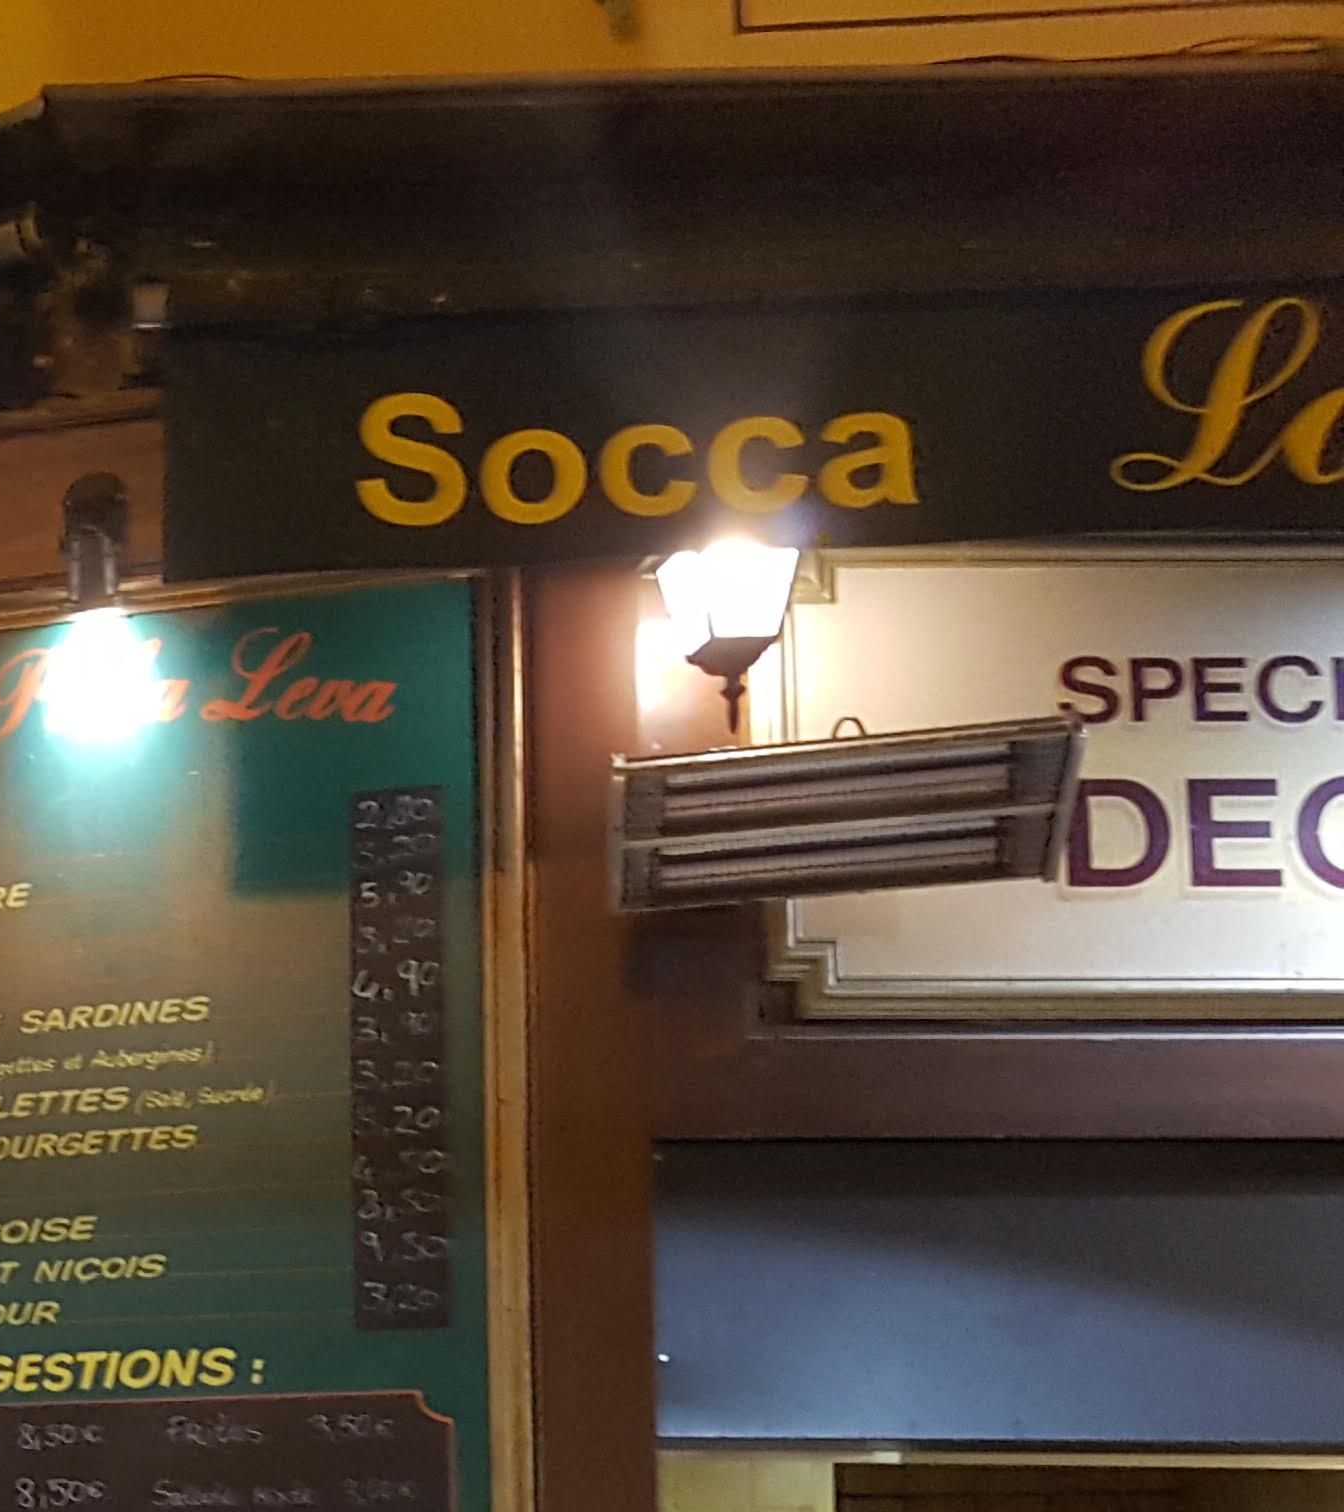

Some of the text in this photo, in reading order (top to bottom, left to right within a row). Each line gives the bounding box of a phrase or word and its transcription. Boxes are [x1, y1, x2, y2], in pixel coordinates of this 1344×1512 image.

[354, 392, 920, 527] Socca
[200, 627, 397, 724] Leva
[20, 995, 210, 1034] SARDINES
